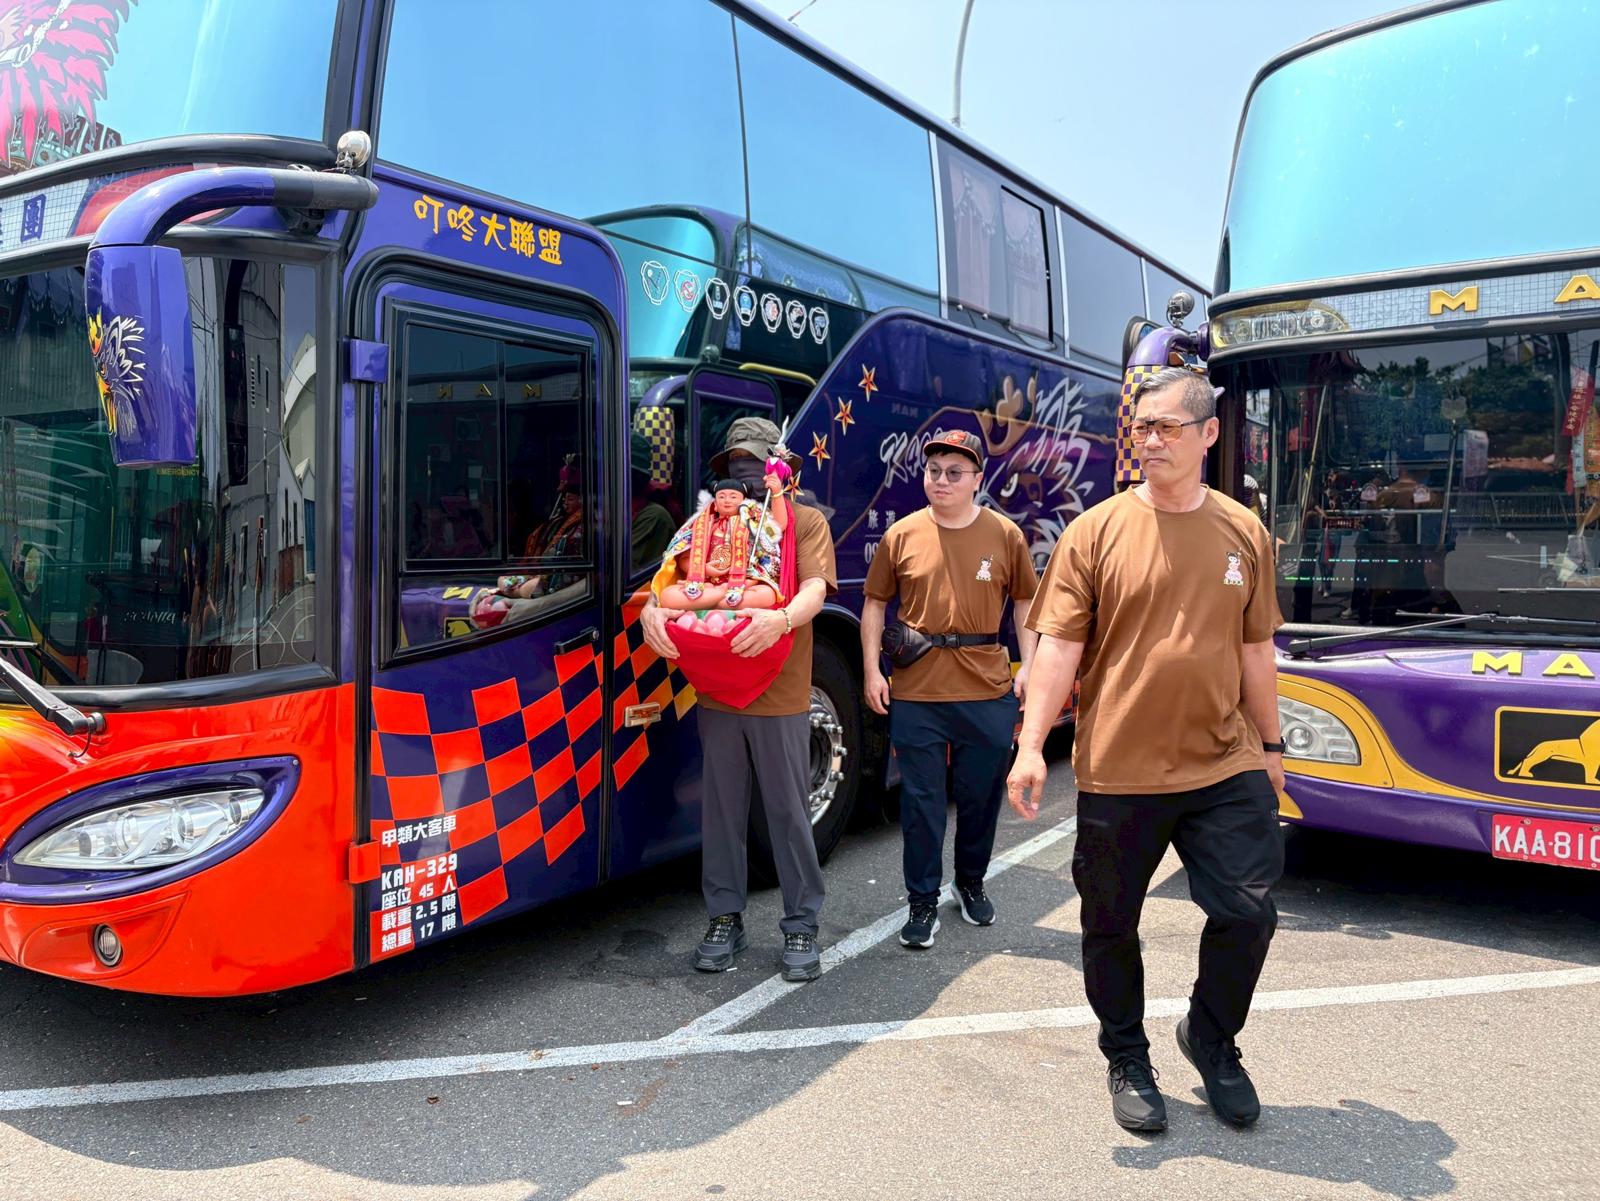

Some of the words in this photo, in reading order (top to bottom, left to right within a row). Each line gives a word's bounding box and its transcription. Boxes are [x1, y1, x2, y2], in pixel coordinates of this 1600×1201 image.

[0, 193, 46, 243] 團
[413, 194, 562, 265] 叮咚大聯盟
[381, 815, 457, 847] 甲類大客車
[381, 853, 457, 891] KAH-329
[381, 887, 411, 911] 座位
[419, 882, 434, 898] 45
[442, 874, 456, 894] 人
[381, 906, 412, 931] 載重
[415, 900, 438, 920] 2.5
[381, 926, 412, 952] 總重
[420, 922, 435, 939] 17
